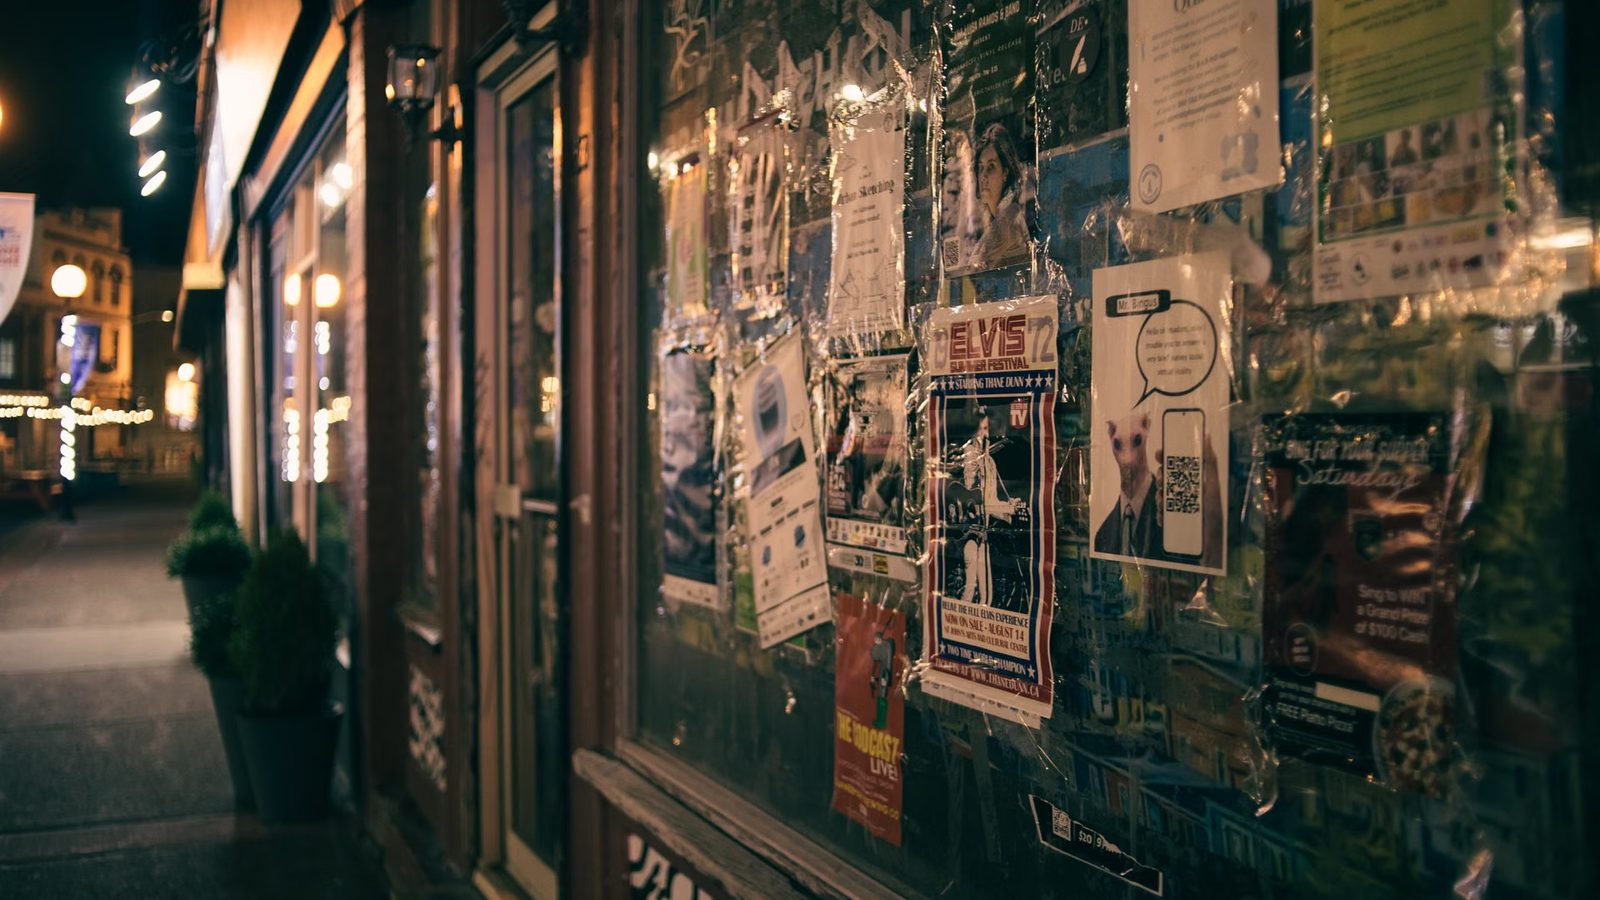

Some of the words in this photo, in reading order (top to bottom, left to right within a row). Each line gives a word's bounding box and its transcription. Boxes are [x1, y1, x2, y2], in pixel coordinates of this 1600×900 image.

[858, 179, 895, 198] Sketching
[949, 314, 1026, 360] ELVIS
[988, 356, 1029, 371] FESTIVAL
[985, 376, 1005, 389] THANE
[1005, 375, 1024, 388] DUNN
[1010, 409, 1027, 426] TV
[958, 603, 967, 614] THE
[968, 606, 980, 617] FULL
[981, 608, 995, 620] ELVIS
[995, 612, 1029, 628] EXPERIENCE
[1366, 603, 1400, 621] Grand
[1401, 607, 1430, 625] Prize
[945, 612, 958, 626] NOW
[959, 616, 968, 627] ON
[969, 617, 984, 632] SALE
[988, 622, 1013, 639] AUGUST
[1015, 629, 1024, 642] 14
[1368, 622, 1397, 639] $100
[1009, 641, 1028, 654] CENTRE
[947, 644, 958, 656] TWO
[959, 647, 972, 660] TIME
[993, 656, 1026, 675] CHAMPION
[852, 720, 900, 765] PODCAST
[1078, 830, 1092, 844] $20
